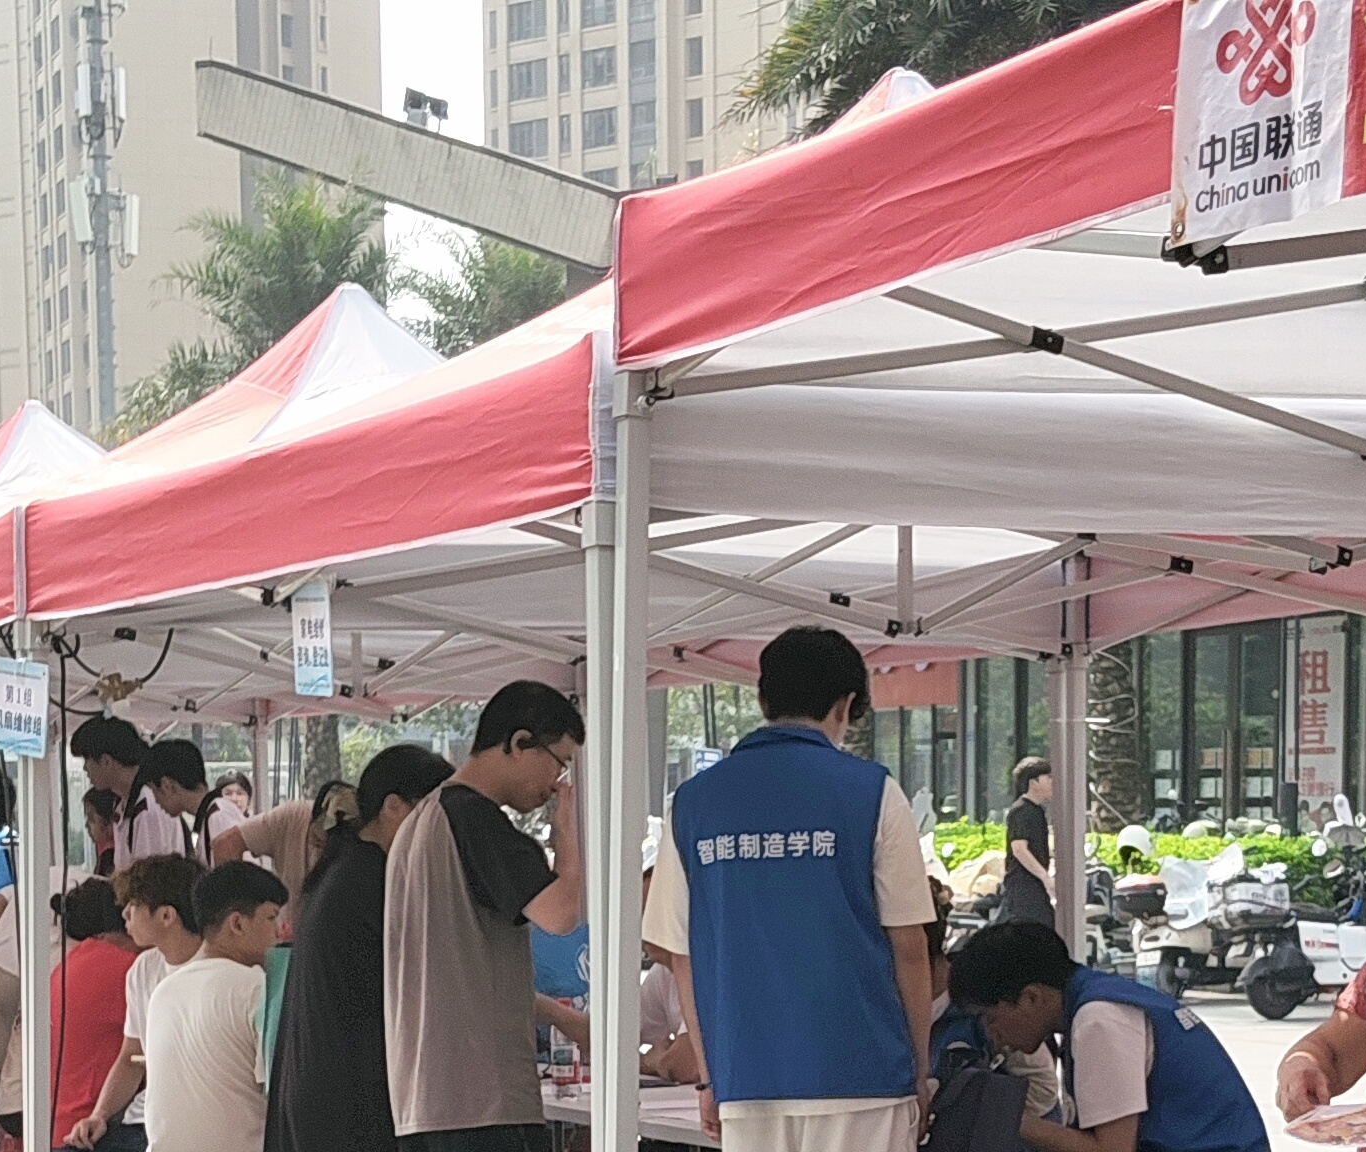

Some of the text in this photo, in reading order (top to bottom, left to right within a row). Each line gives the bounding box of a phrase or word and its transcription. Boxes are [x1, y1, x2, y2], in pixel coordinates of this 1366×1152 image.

[1198, 100, 1323, 179] 中国联通
[1195, 159, 1321, 213] China unicom
[1299, 650, 1331, 745] 租售
[697, 829, 836, 866] 智能制造学院
